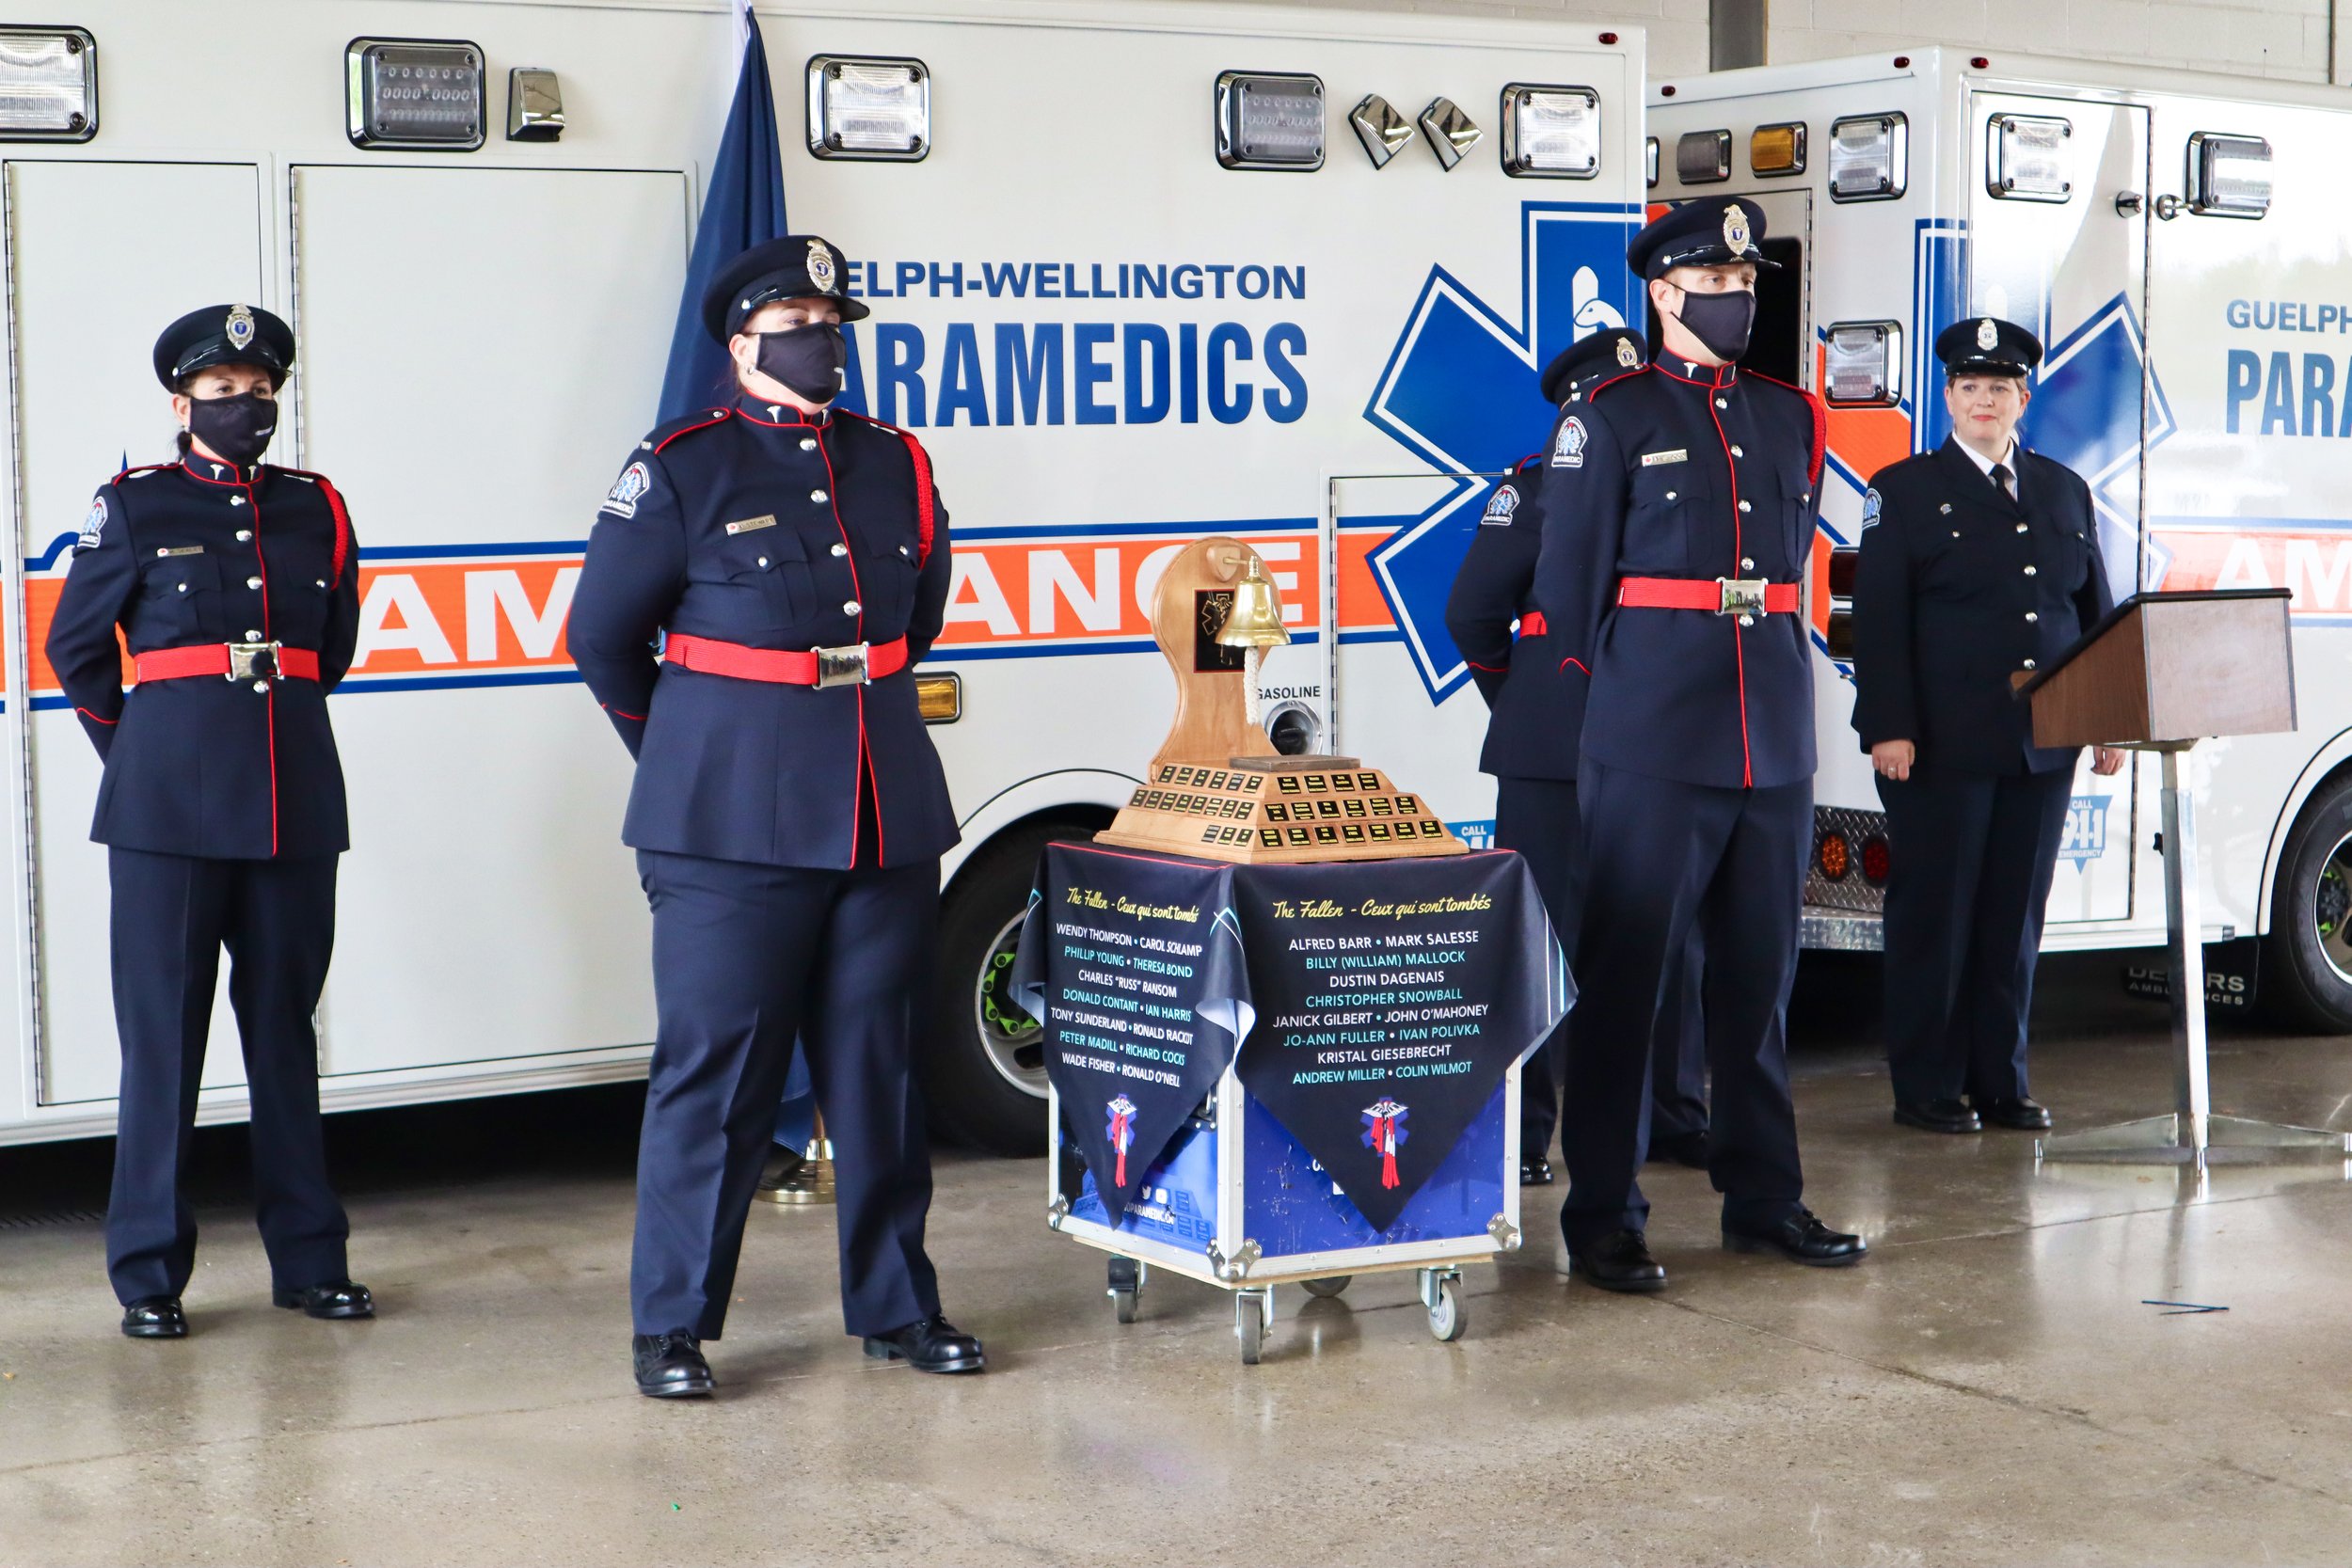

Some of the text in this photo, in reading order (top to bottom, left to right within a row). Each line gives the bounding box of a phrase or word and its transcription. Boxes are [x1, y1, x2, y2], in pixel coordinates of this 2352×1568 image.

[846, 261, 1306, 299] ELPH-WELLINGTON
[833, 322, 1309, 428] ARAMEDICS
[2072, 800, 2092, 809] CALL
[1461, 825, 1486, 837] CALL
[1067, 887, 1082, 904] The
[1084, 890, 1108, 910] Fallen
[1117, 896, 1136, 914] Ceux
[1137, 904, 1152, 921] qui
[1152, 906, 1173, 920] sont
[1272, 901, 1295, 919] The
[1299, 899, 1343, 919] Fallen
[1360, 899, 1393, 917] Ceux
[1395, 900, 1418, 921] qui
[1420, 896, 1444, 913] sont
[1445, 893, 1492, 911] tombés
[1056, 923, 1088, 938] WENDY
[1089, 928, 1132, 947] THOMPSON
[1140, 937, 1166, 952] CAROL
[1289, 930, 1479, 951] ALFRED BARR MARK SALESSE
[1064, 945, 1193, 978] PHILLIP YOUNG THERESA BOND
[1306, 950, 1466, 970] BILLY (WILLIAM) MALLOCK
[1078, 969, 1113, 987] CHARLES
[1142, 981, 1177, 998] RANSOM
[1329, 971, 1445, 988] DUSTIN DAGENAIS
[1063, 989, 1191, 1022] DONALD CONTANT IAN HARRIS
[1305, 988, 1463, 1008] CHRISTOPHER SNOWBALL
[1051, 1007, 1073, 1021] TONY
[1074, 1012, 1127, 1032] SUNDERLAND
[1133, 1022, 1164, 1039] RONALD
[1272, 1005, 1489, 1028] JANICK GILBERT JOHN O'MAHONEY
[1059, 1031, 1086, 1046] PETER
[1088, 1036, 1118, 1053] MADILL
[1126, 1043, 1160, 1060] RICHARD
[1283, 1023, 1480, 1047] JO-ANN FULLER IVAN POLIVKA
[1062, 1053, 1087, 1069] WADE
[1088, 1057, 1115, 1074] FISHER
[1122, 1064, 1154, 1082] RONALD
[1317, 1044, 1453, 1064] KRISTAL GIESEBRECHT
[1293, 1061, 1472, 1085] ANDREW MILLER COLIN WILMOT
